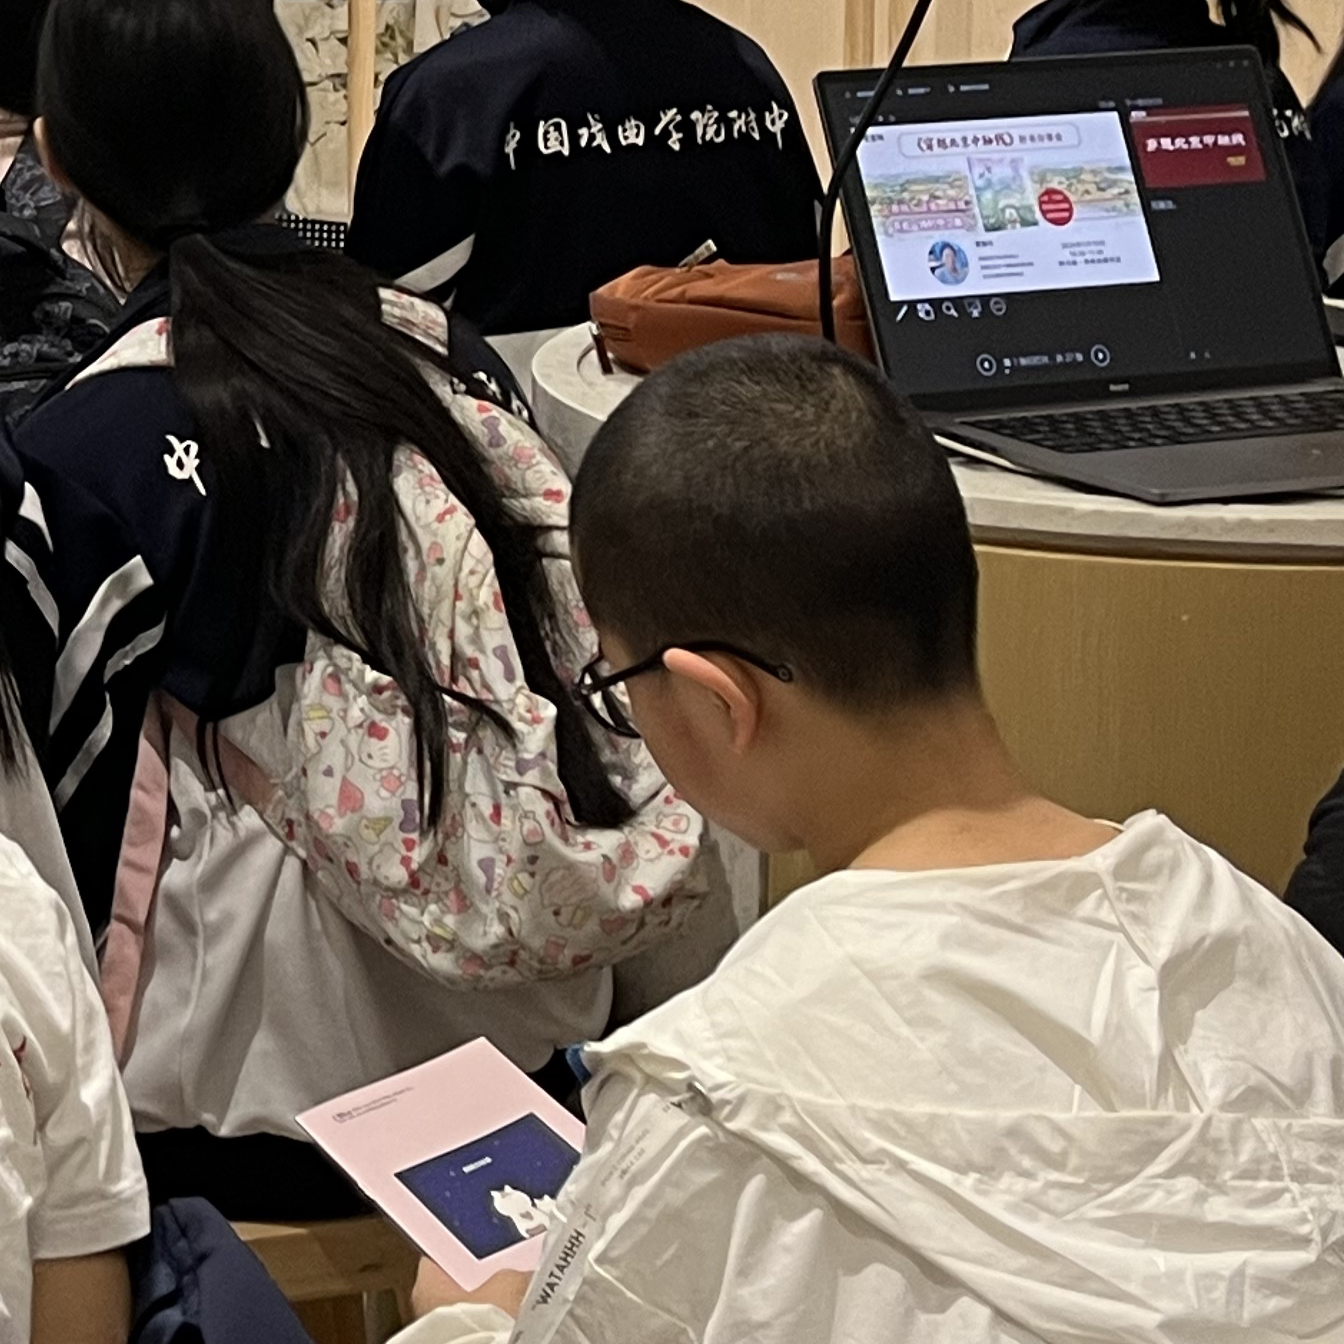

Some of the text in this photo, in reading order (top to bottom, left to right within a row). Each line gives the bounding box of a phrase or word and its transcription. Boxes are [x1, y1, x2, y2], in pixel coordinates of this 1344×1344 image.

[503, 101, 789, 170] 中国戏曲学院附中
[163, 434, 207, 497] 中
